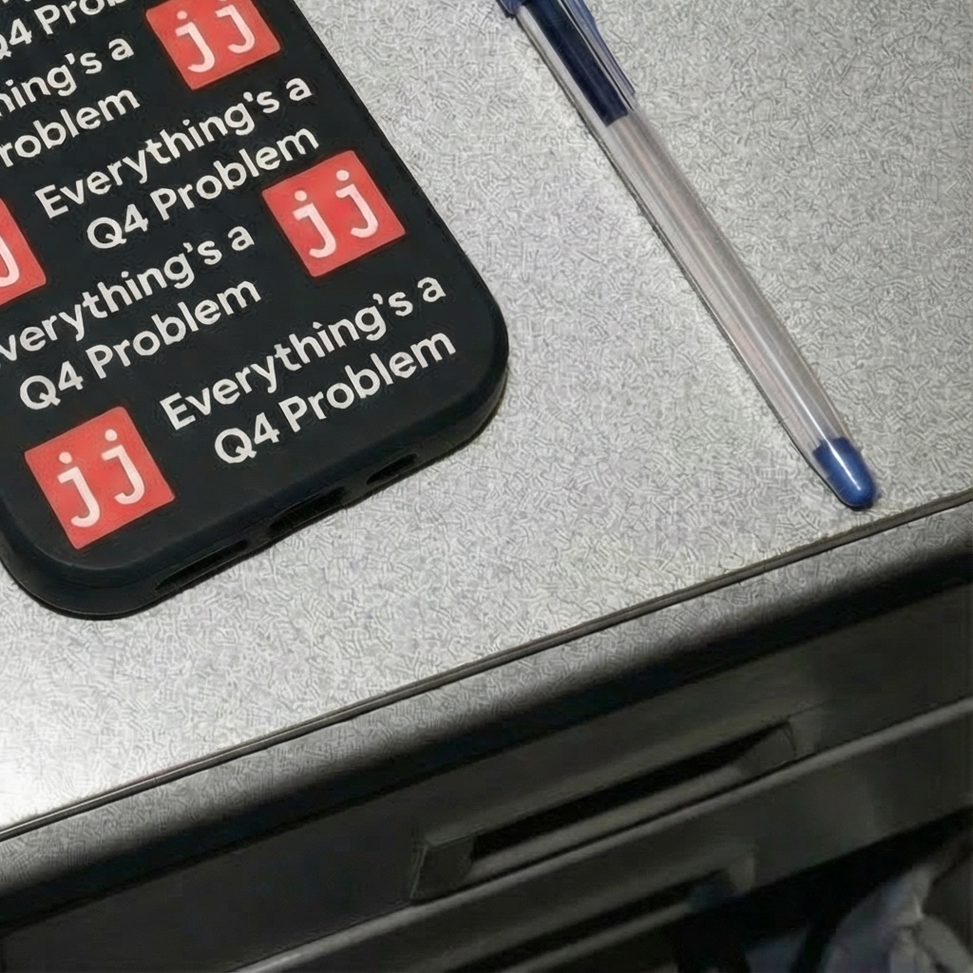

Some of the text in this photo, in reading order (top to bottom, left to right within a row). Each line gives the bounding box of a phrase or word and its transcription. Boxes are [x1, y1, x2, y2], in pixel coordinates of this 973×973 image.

[108, 37, 134, 60] a
[35, 77, 312, 219] Everything's a
[86, 129, 320, 249] Q4 Problem
[228, 226, 255, 250] a
[19, 279, 262, 410] Q4 Problem
[160, 277, 446, 431] Everything's a
[214, 332, 456, 464] Q4 Problem
